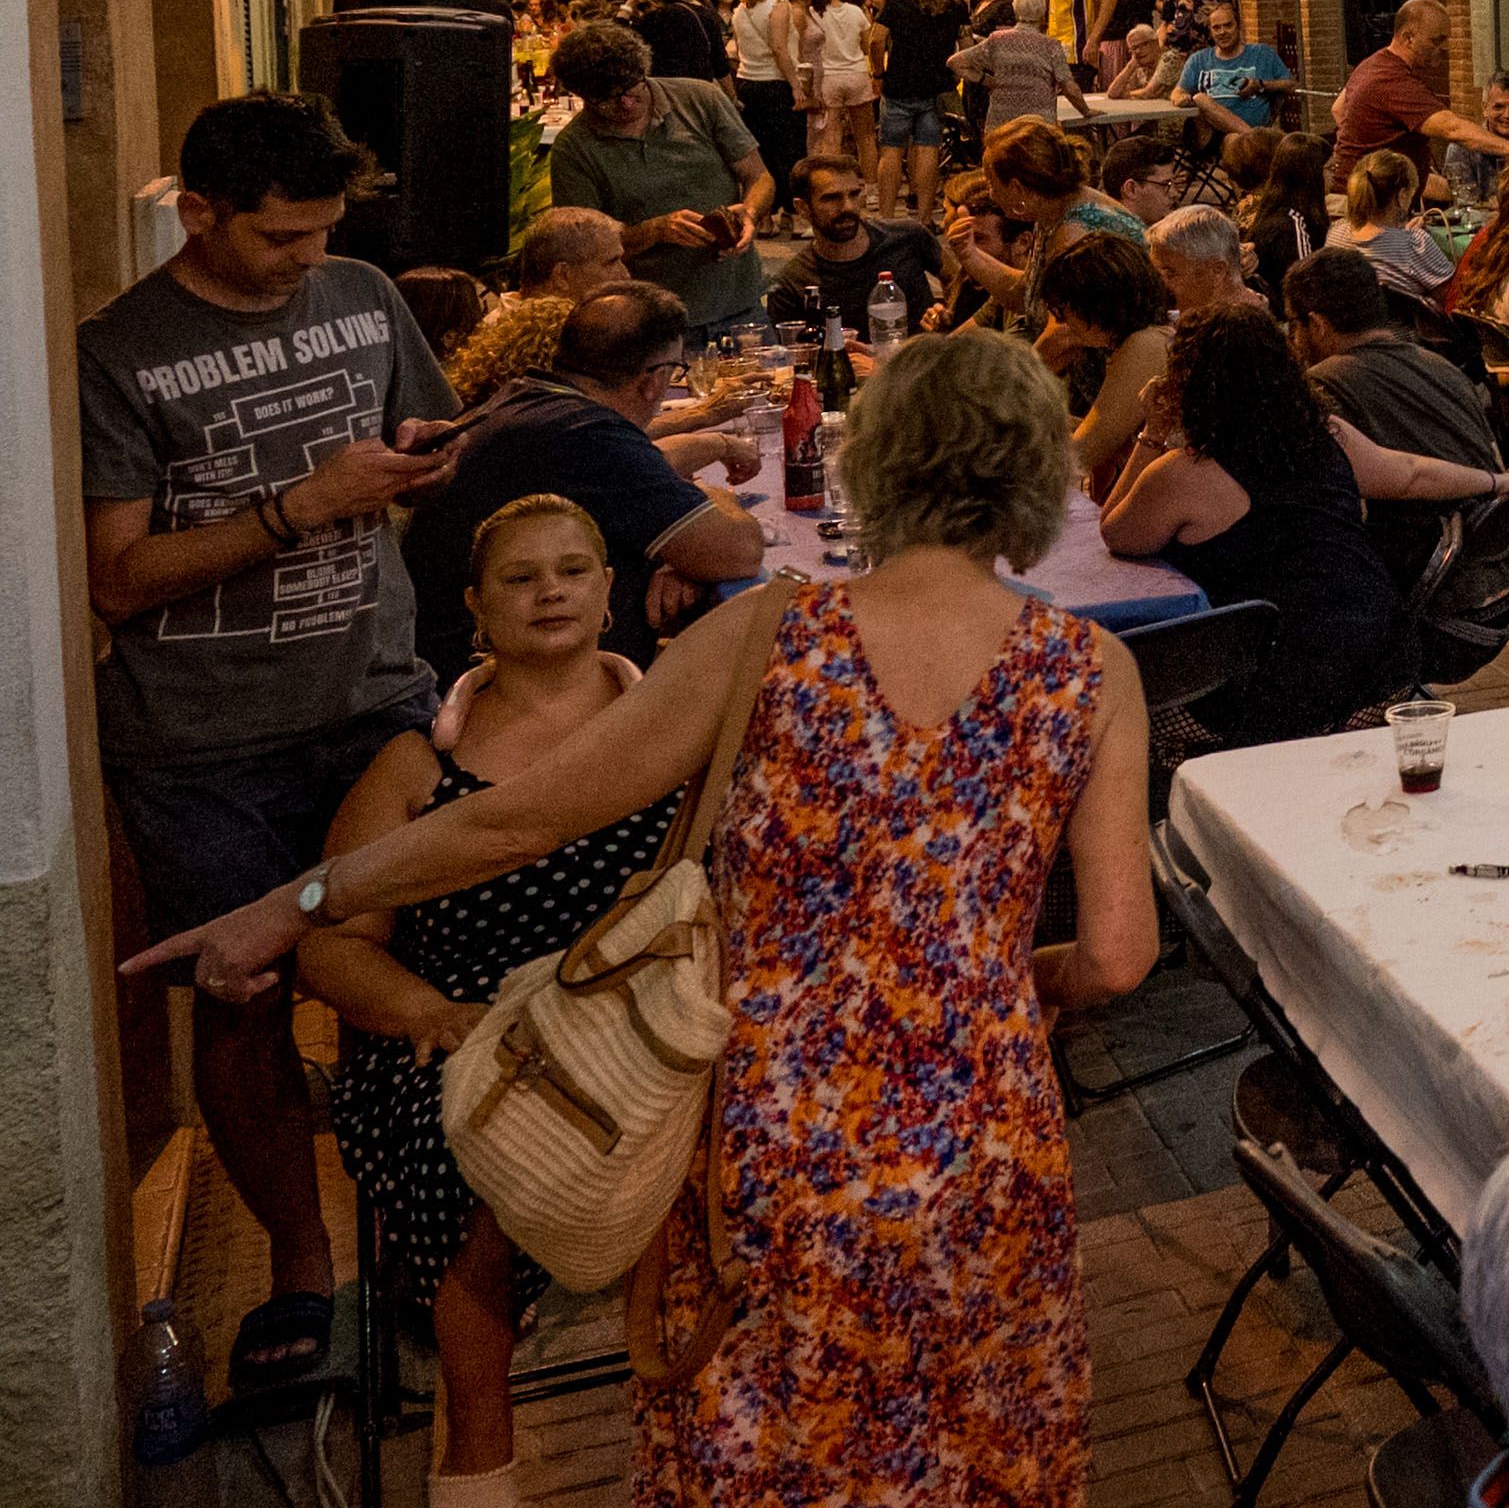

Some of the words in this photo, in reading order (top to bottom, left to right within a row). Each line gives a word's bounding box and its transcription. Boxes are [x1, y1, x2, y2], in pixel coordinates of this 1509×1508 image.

[136, 337, 289, 404] PROBLEM
[291, 309, 390, 365] SOLVING
[253, 402, 284, 421] DOES
[282, 398, 295, 413] IT
[294, 386, 335, 411] WORK?
